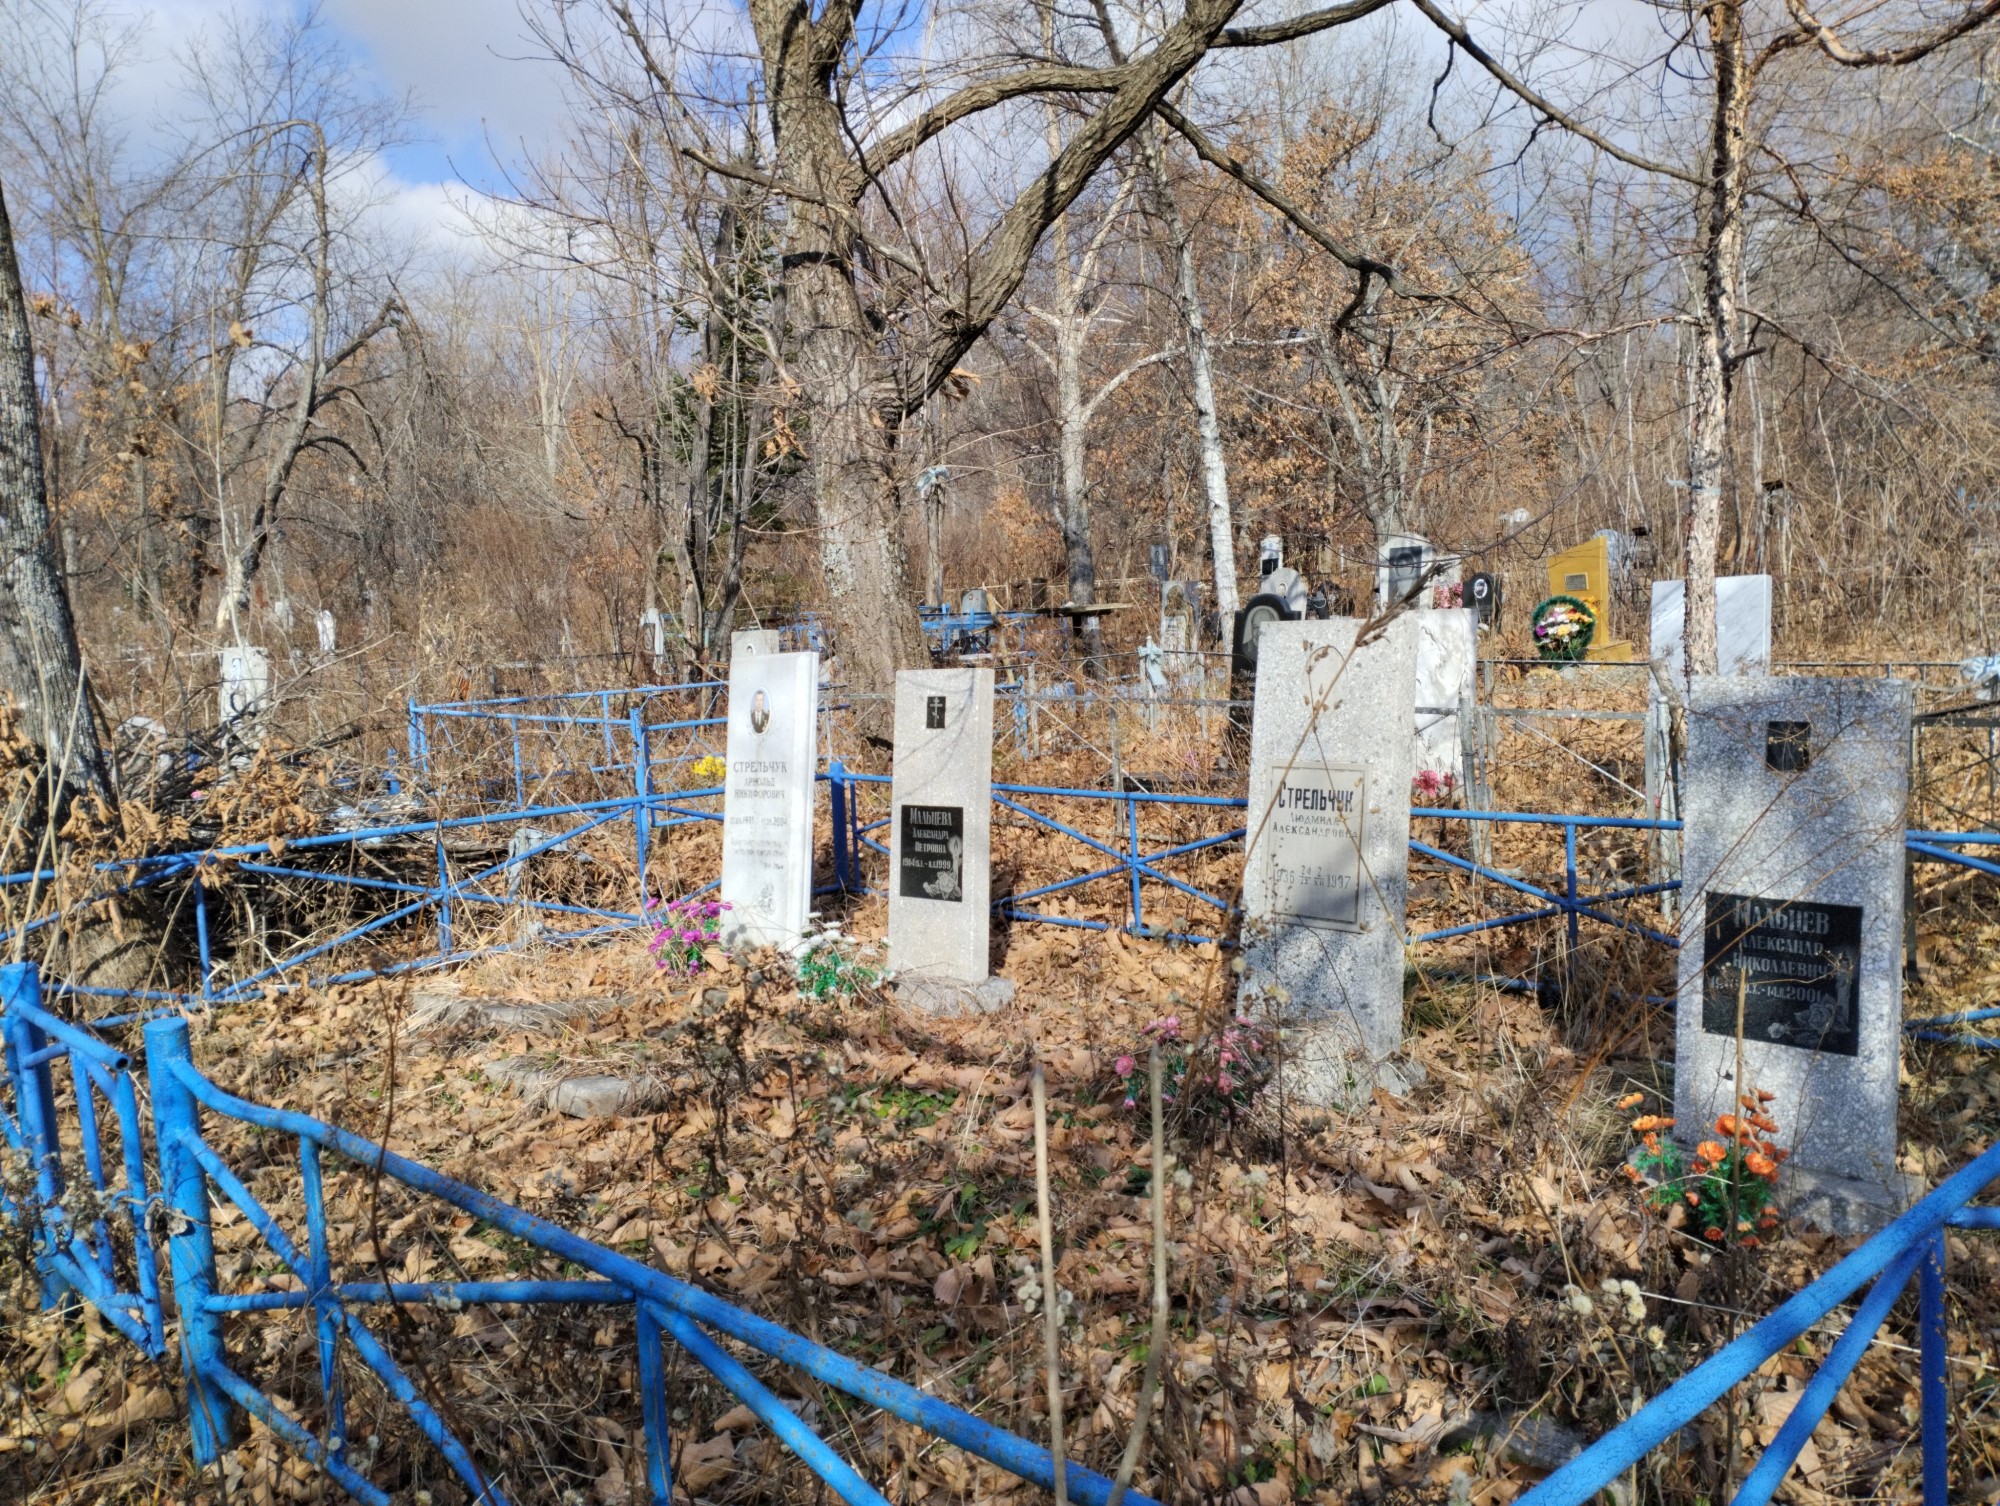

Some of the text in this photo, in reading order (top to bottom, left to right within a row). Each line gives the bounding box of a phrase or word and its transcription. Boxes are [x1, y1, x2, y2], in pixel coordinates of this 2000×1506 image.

[733, 762, 787, 773] СТРЕЛЬЧУК
[734, 789, 785, 799] НИКИФОРОВИЧ
[1279, 780, 1354, 812] СТРЕЛЬЧУК
[910, 808, 952, 826] МАЛЬЦЕВА
[912, 827, 949, 840] АЛЕКСАНДРА
[914, 841, 947, 854] ПЕТРОВНА
[1326, 874, 1351, 889] 1997
[1733, 899, 1830, 935] МАЛЬЦЕВ
[1739, 934, 1824, 956] АЛЕКСАНДР
[1733, 951, 1829, 978] НИКОЛАЕВИЧ
